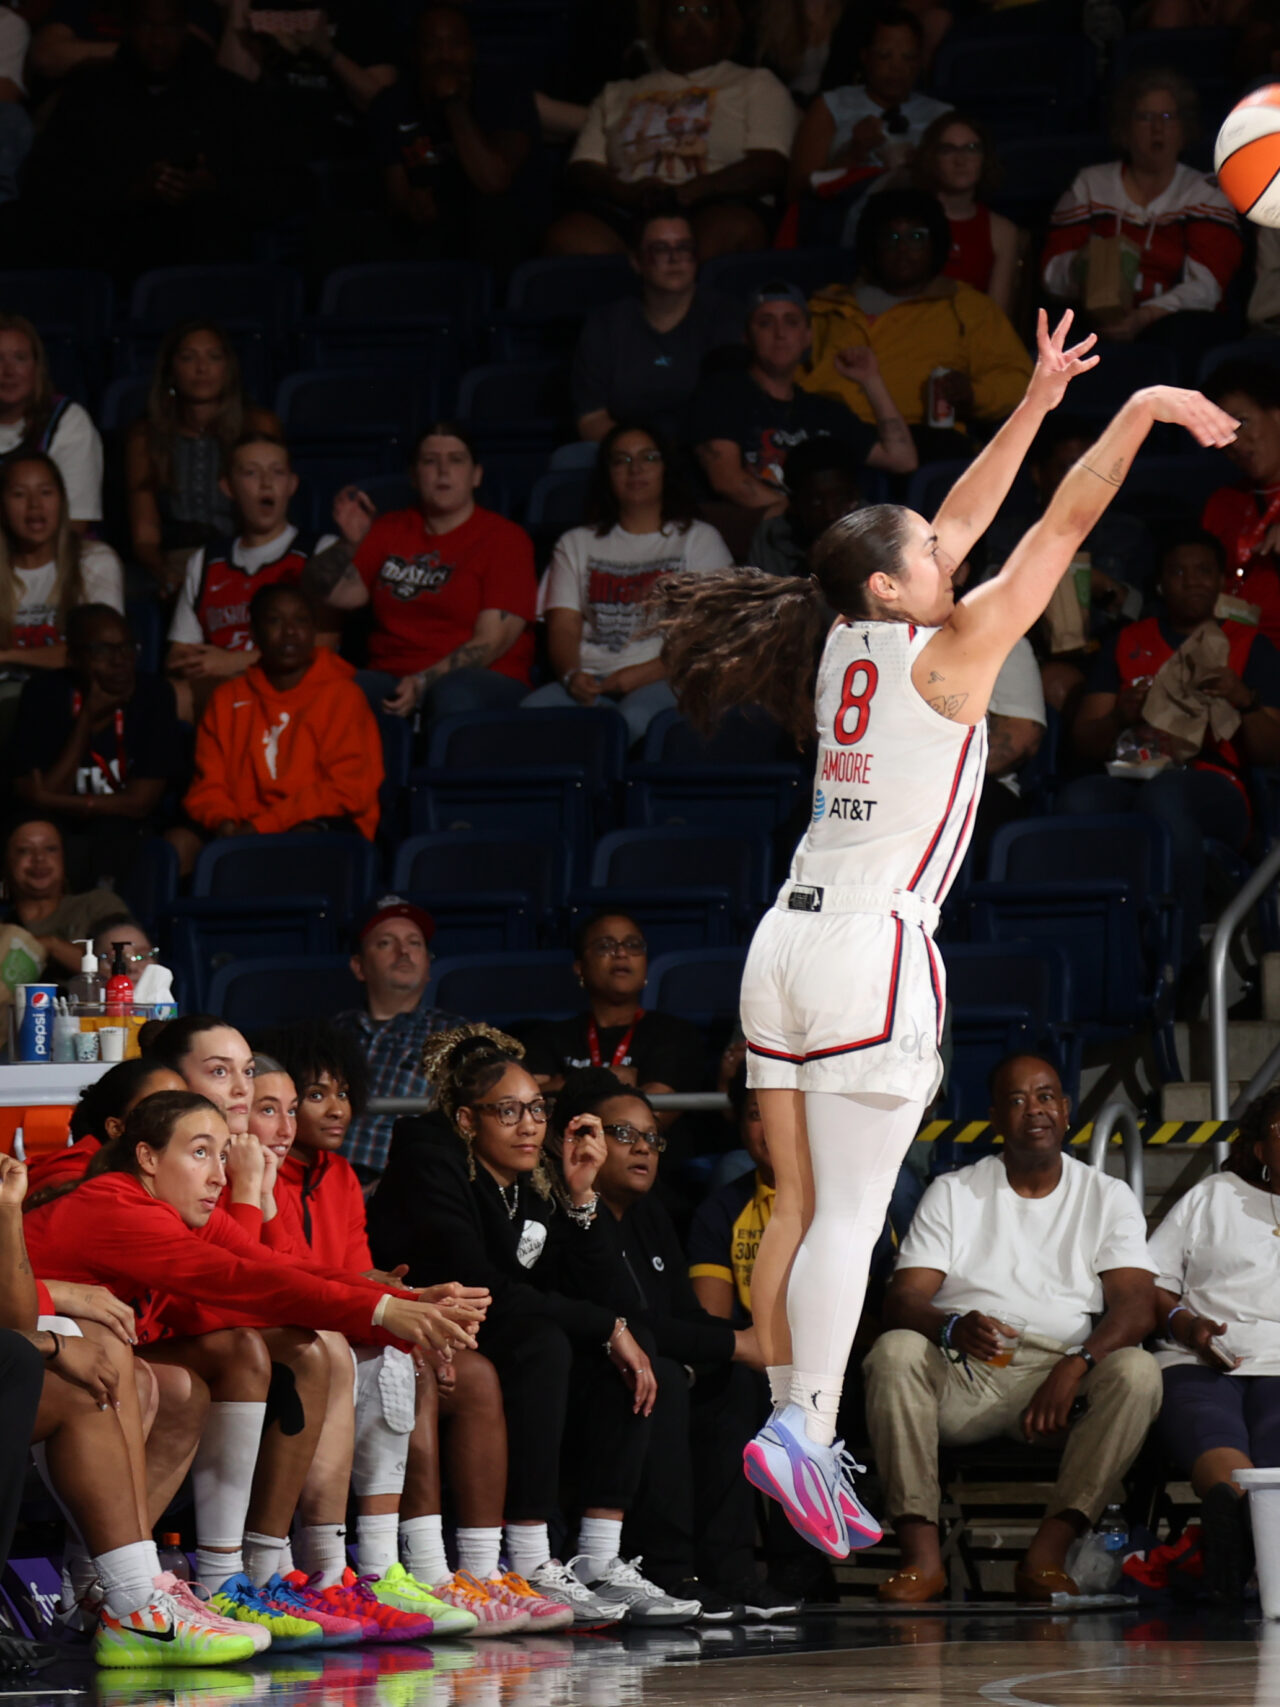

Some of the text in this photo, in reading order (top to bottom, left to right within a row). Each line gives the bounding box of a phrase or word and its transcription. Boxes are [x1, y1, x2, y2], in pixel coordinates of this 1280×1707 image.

[833, 658, 879, 746] 8
[821, 751, 874, 785] AMOORE
[829, 797, 878, 822] AT&T
[32, 1012, 48, 1056] pepsi
